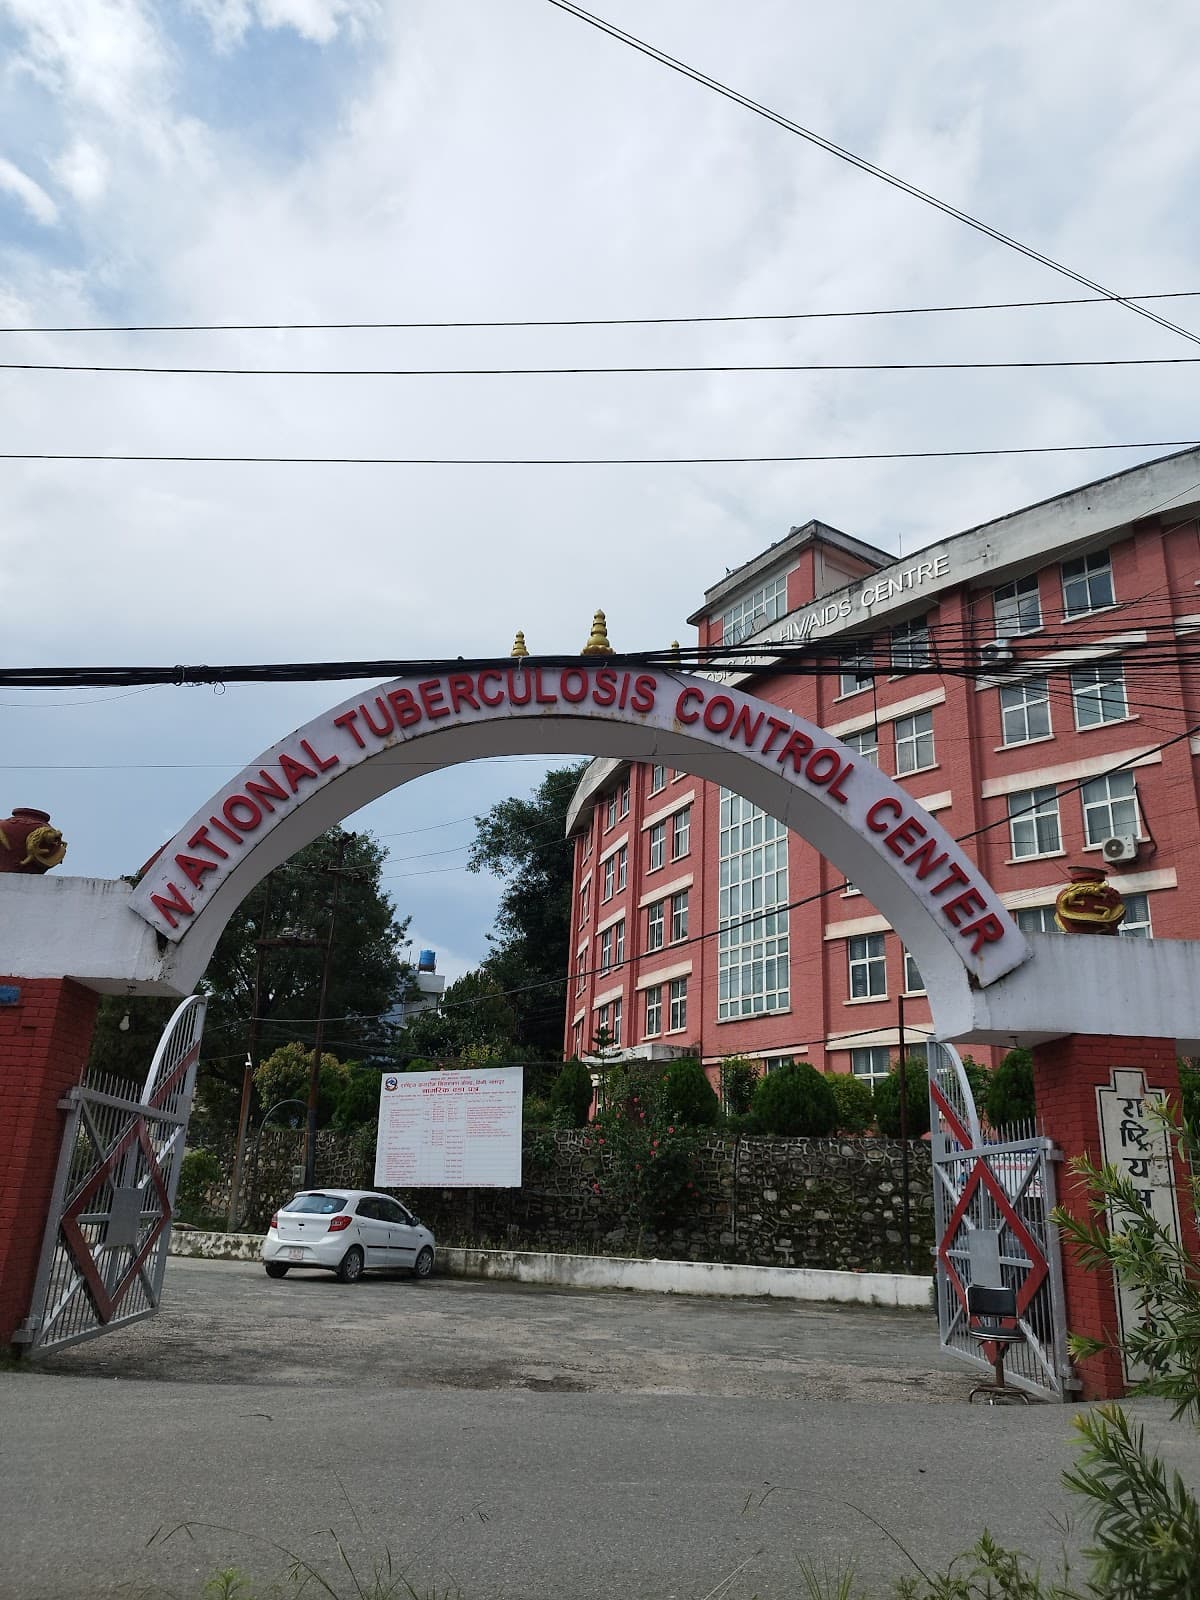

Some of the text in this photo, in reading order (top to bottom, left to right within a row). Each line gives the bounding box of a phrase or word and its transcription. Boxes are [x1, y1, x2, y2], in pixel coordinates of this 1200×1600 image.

[779, 598, 852, 642] HIV/AIDS
[861, 554, 950, 608] CENTRE
[149, 666, 1006, 955] NATIONAL TUBERCULOSIS CONTROL CENTER
